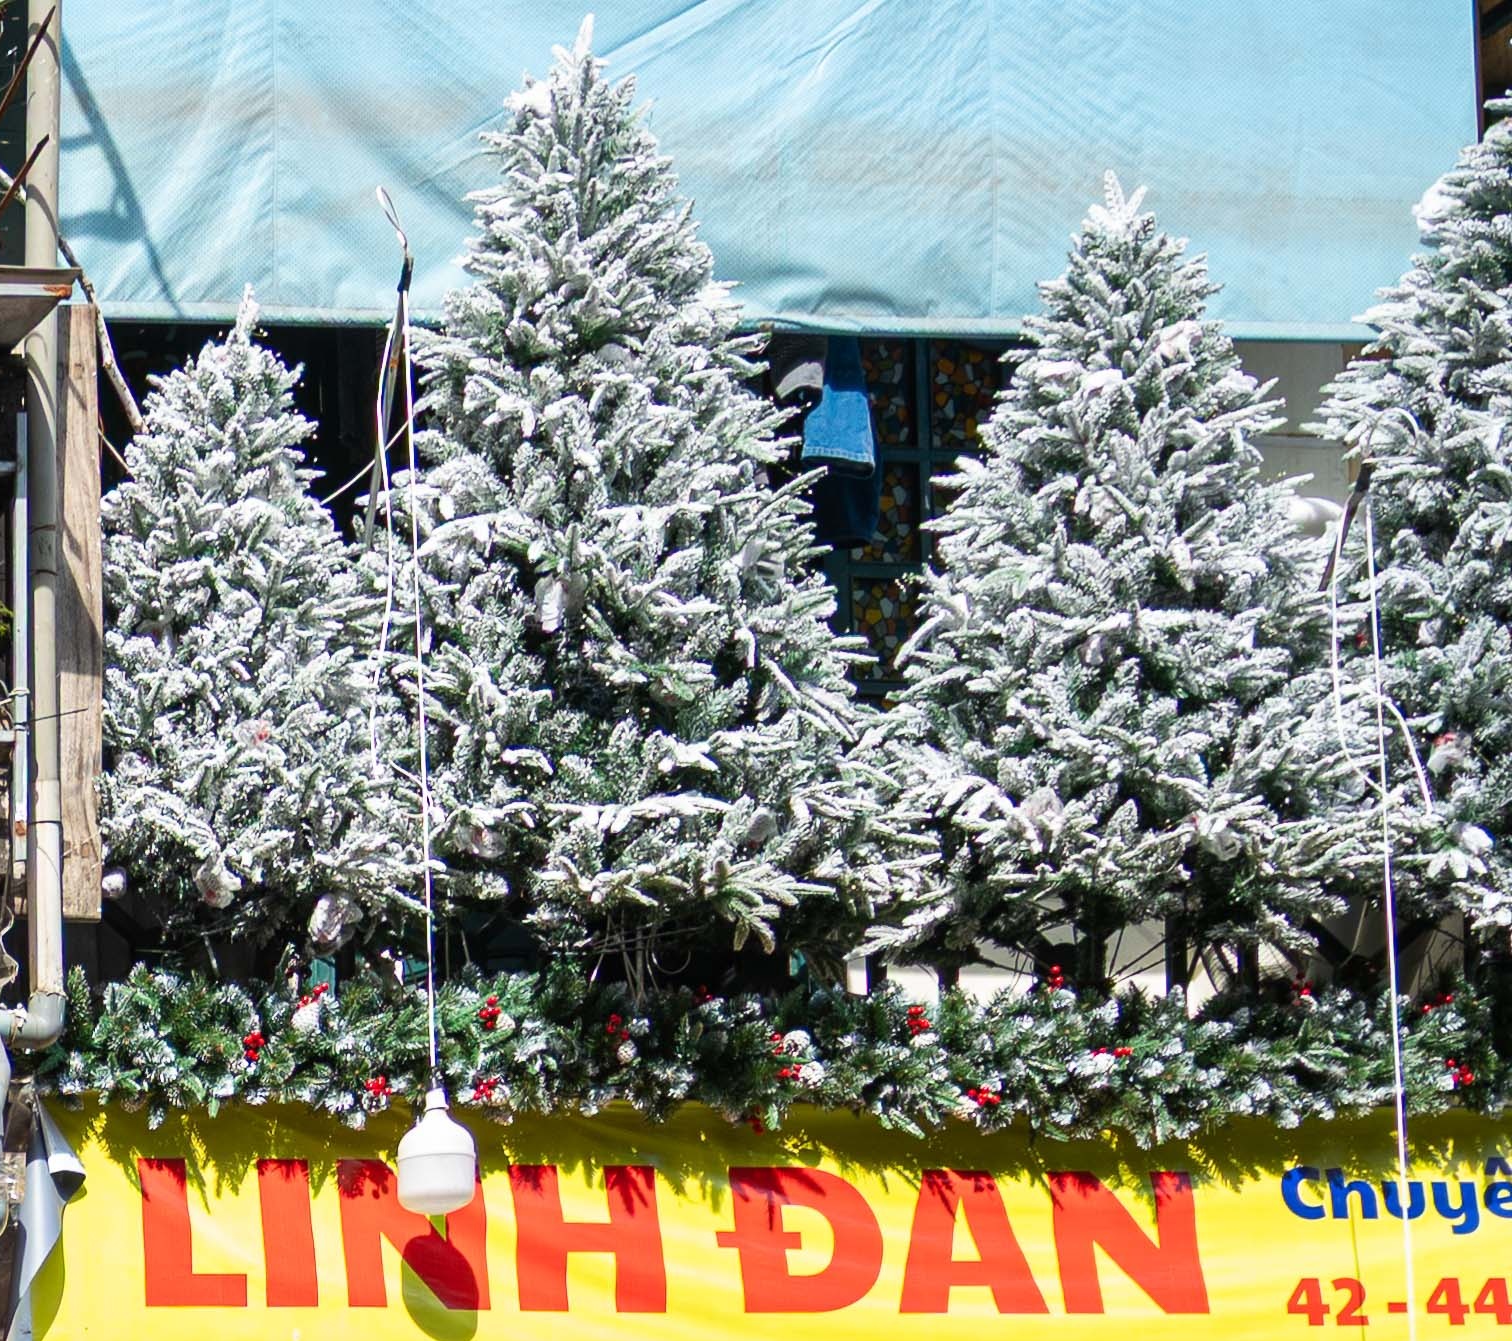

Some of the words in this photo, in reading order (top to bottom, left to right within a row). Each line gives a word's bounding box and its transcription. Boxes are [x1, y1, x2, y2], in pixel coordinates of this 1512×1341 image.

[138, 1157, 667, 1311] LINH
[716, 1164, 1210, 1314] ĐAN
[1287, 1277, 1369, 1326] 42
